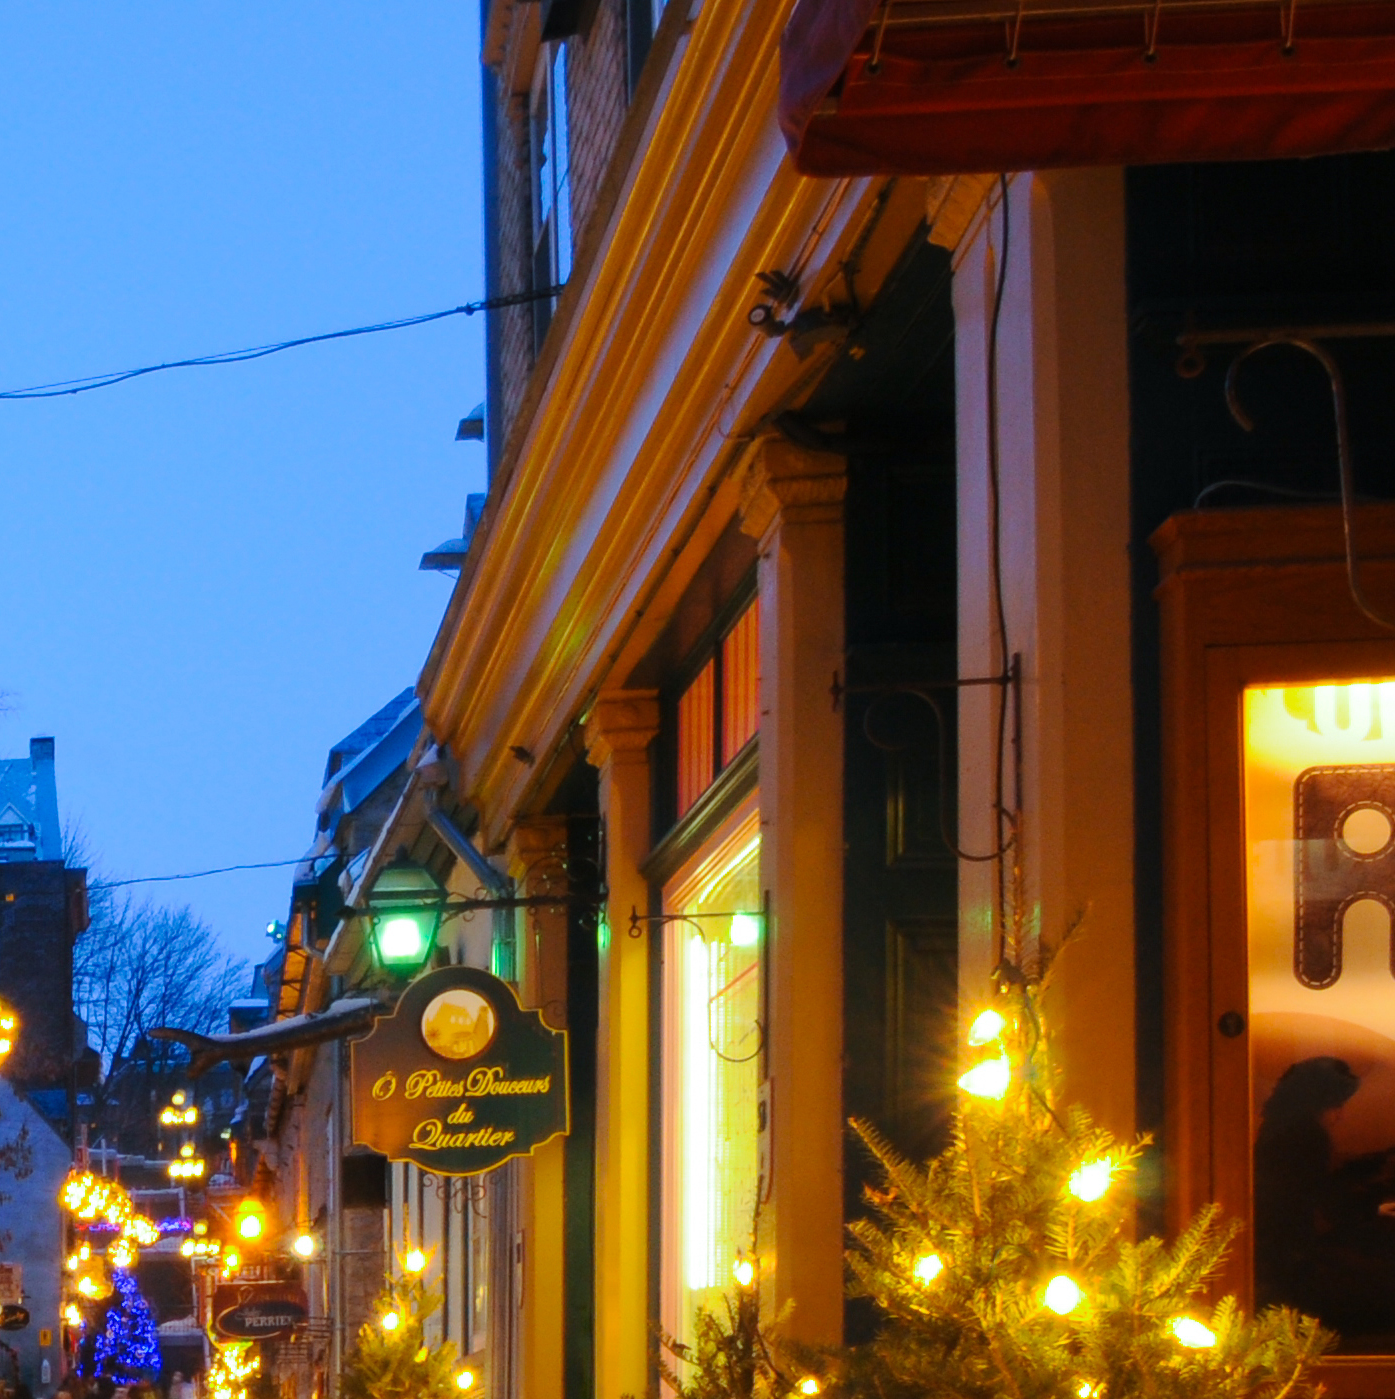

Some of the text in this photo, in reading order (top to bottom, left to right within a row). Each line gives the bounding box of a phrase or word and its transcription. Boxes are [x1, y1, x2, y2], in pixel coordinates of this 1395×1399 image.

[405, 1070, 464, 1099] Petites
[465, 1067, 551, 1097] Douceurs
[447, 1103, 474, 1124] du
[409, 1119, 516, 1150] Quartier
